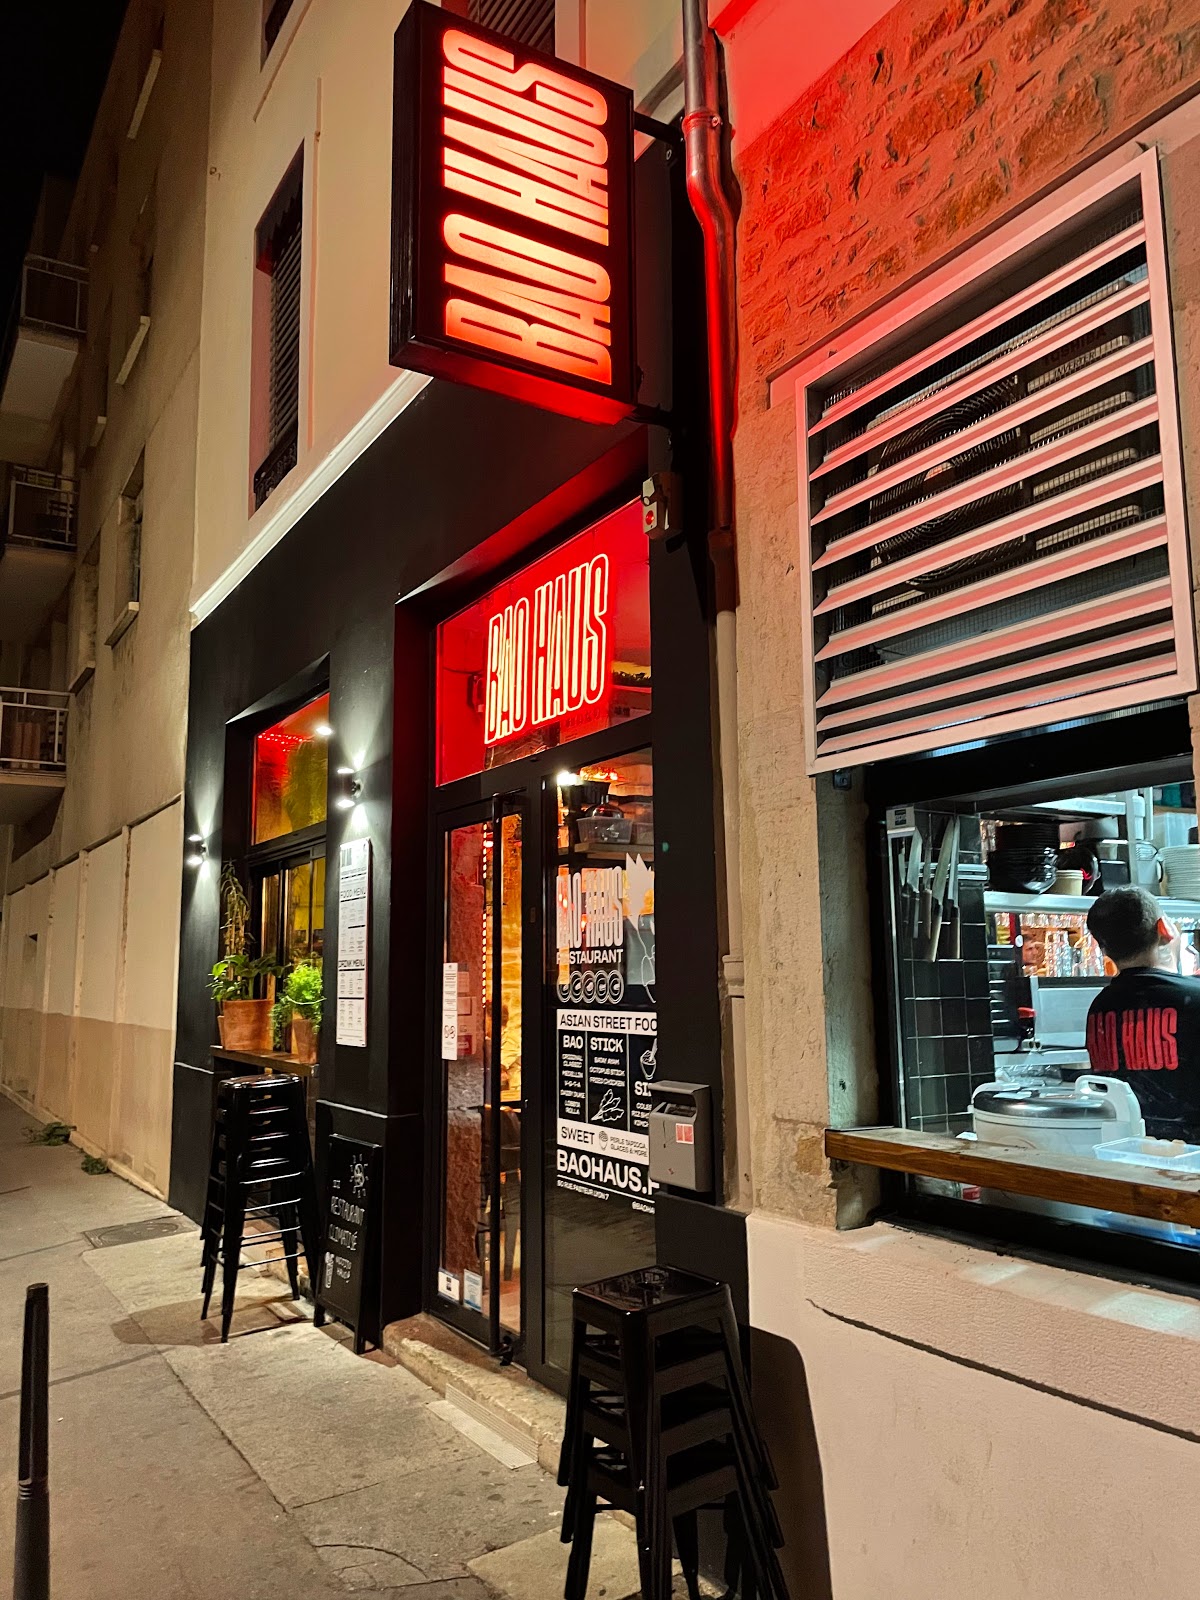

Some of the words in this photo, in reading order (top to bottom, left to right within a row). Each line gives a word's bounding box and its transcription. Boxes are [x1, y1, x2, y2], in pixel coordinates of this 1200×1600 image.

[442, 29, 609, 246] HAUS
[443, 213, 612, 385] BAO
[484, 597, 530, 745] BAO
[531, 553, 609, 726] HAUS
[354, 887, 366, 896] MENU
[556, 872, 582, 949] BAO
[585, 866, 623, 948] HAUS
[353, 958, 366, 968] MENU
[560, 1014, 592, 1028] ASIAN
[593, 1015, 633, 1030] STREET
[563, 1035, 583, 1049] BAO
[591, 1037, 623, 1052] STICK
[1122, 1007, 1179, 1071] HAUS
[610, 1068, 626, 1077] STICK
[604, 1078, 626, 1087] CHICKEN
[561, 1126, 595, 1145] SWEET
[634, 1149, 648, 1158] MORE
